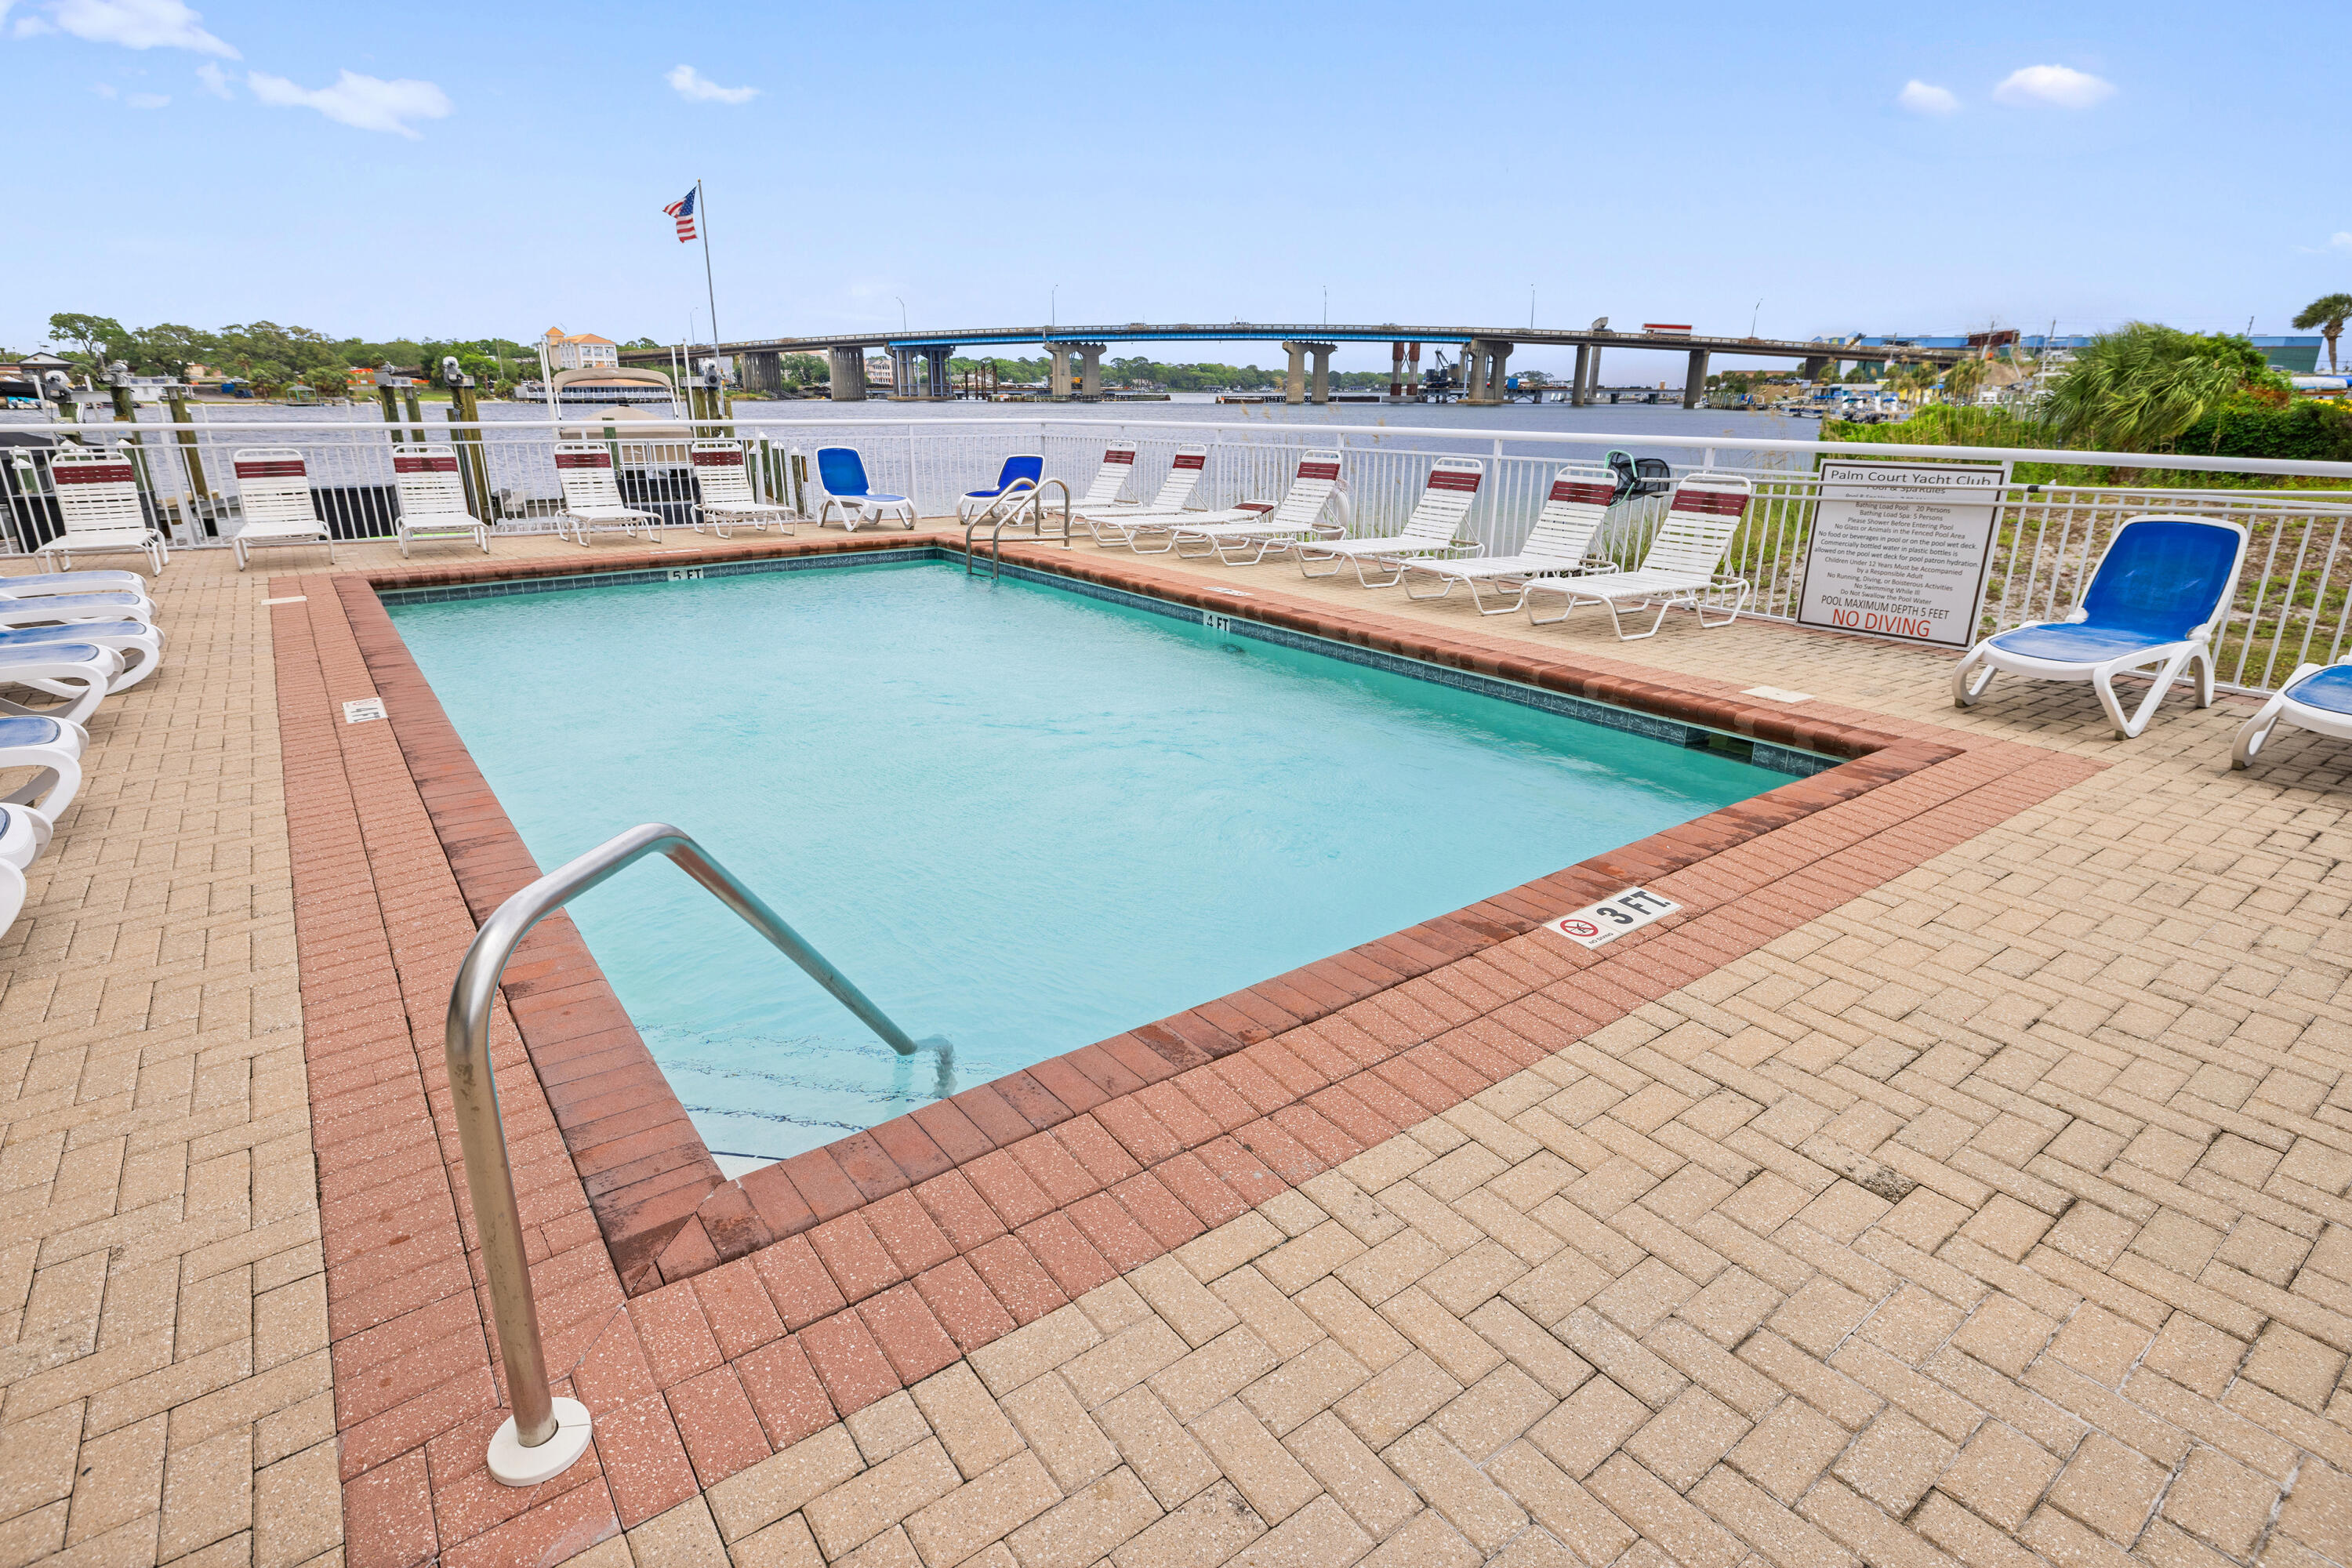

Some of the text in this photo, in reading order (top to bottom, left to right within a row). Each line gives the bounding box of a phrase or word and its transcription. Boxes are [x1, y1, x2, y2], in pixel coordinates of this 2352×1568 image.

[1831, 470, 1991, 485] Palm Court Yacht Club
[1912, 521, 1937, 530] Entering
[1820, 539, 1859, 548] Commercially
[1947, 559, 1980, 568] hydration.
[673, 568, 701, 579] 5 FT
[1871, 568, 1905, 577] Responsible
[1920, 566, 1962, 575] Accompanied
[1836, 573, 1860, 582] Running,
[1892, 579, 1923, 588] Boisterous
[1925, 583, 1953, 591] Activities
[1864, 584, 1894, 593] Swimming
[1862, 590, 1886, 599] Swallow
[1821, 595, 1950, 619] POOL MAXIMUM DEPTH 5 FEET
[1207, 615, 1229, 631] 4 FT
[1832, 608, 1931, 637] NO DIVING
[1596, 891, 1671, 924] 3 FT.
